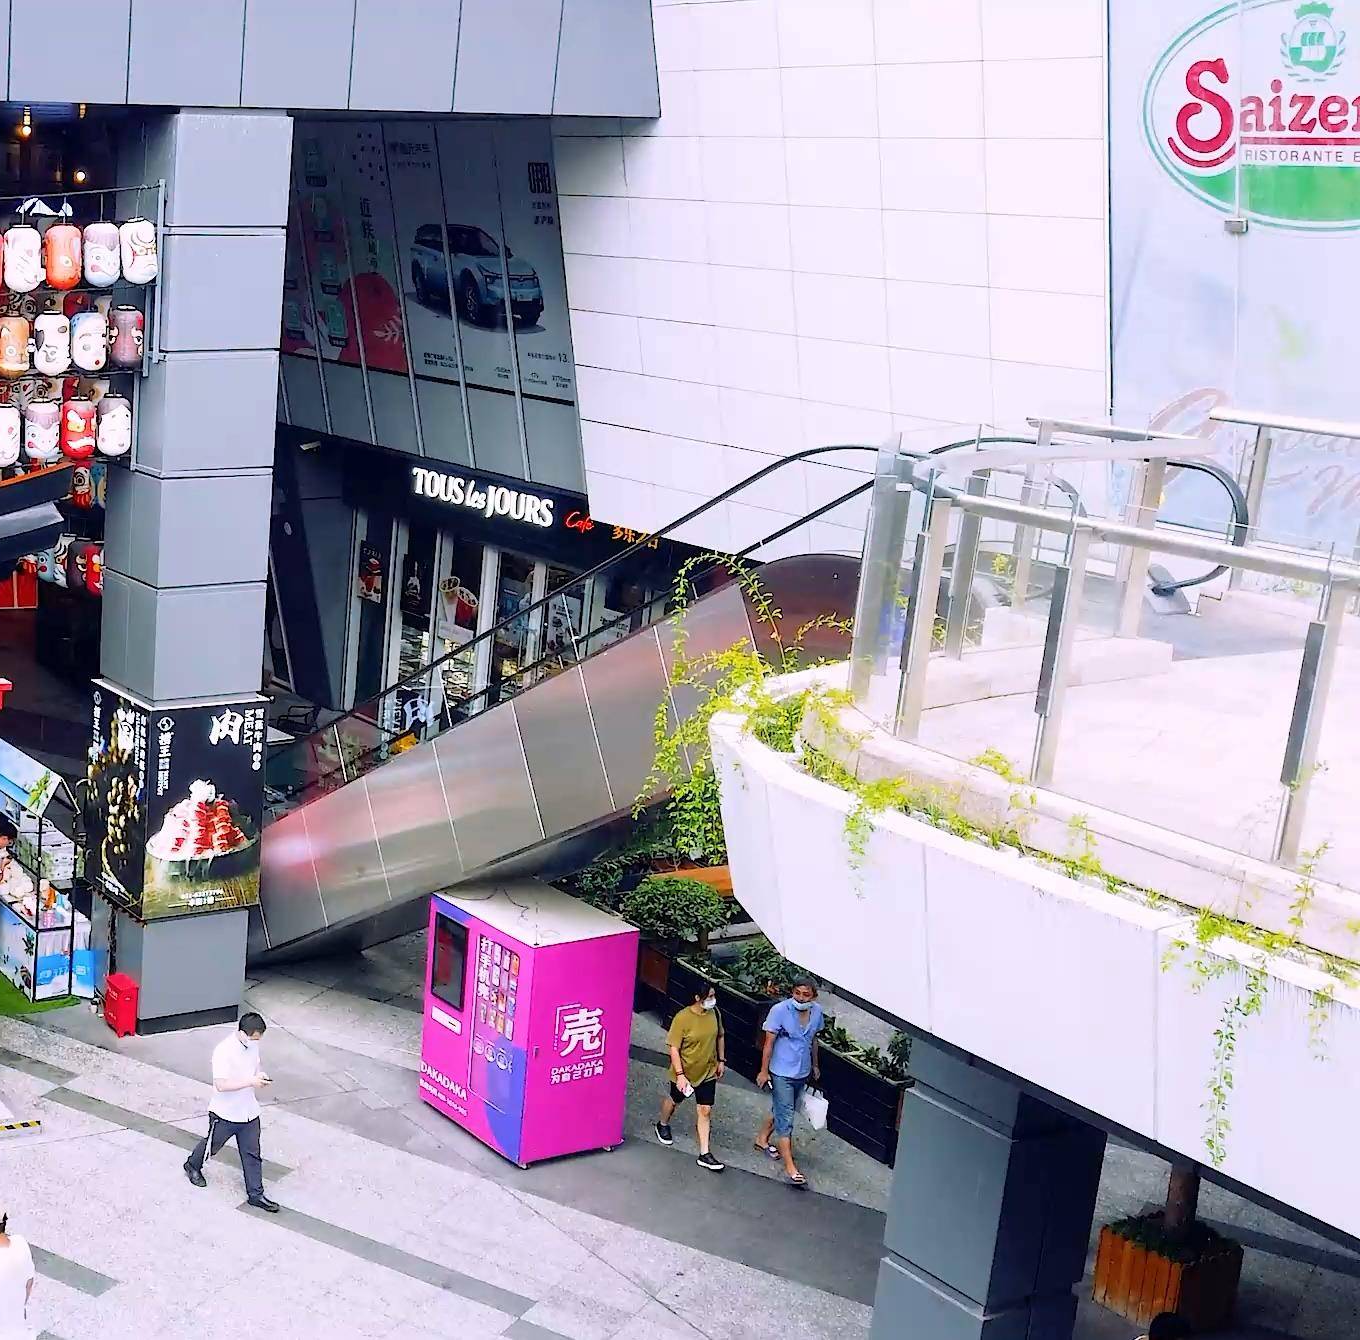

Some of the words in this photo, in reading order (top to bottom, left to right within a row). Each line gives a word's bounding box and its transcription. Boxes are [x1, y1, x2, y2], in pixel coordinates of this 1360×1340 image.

[1245, 150, 1344, 162] RISTORANTE
[412, 467, 464, 505] TOUS
[464, 479, 487, 510] les
[485, 485, 554, 528] JOURS
[209, 708, 245, 745] 肉
[243, 709, 255, 746] MEAT
[420, 1060, 468, 1101] DAKADAKA
[551, 1060, 604, 1076] DAKADAKA
